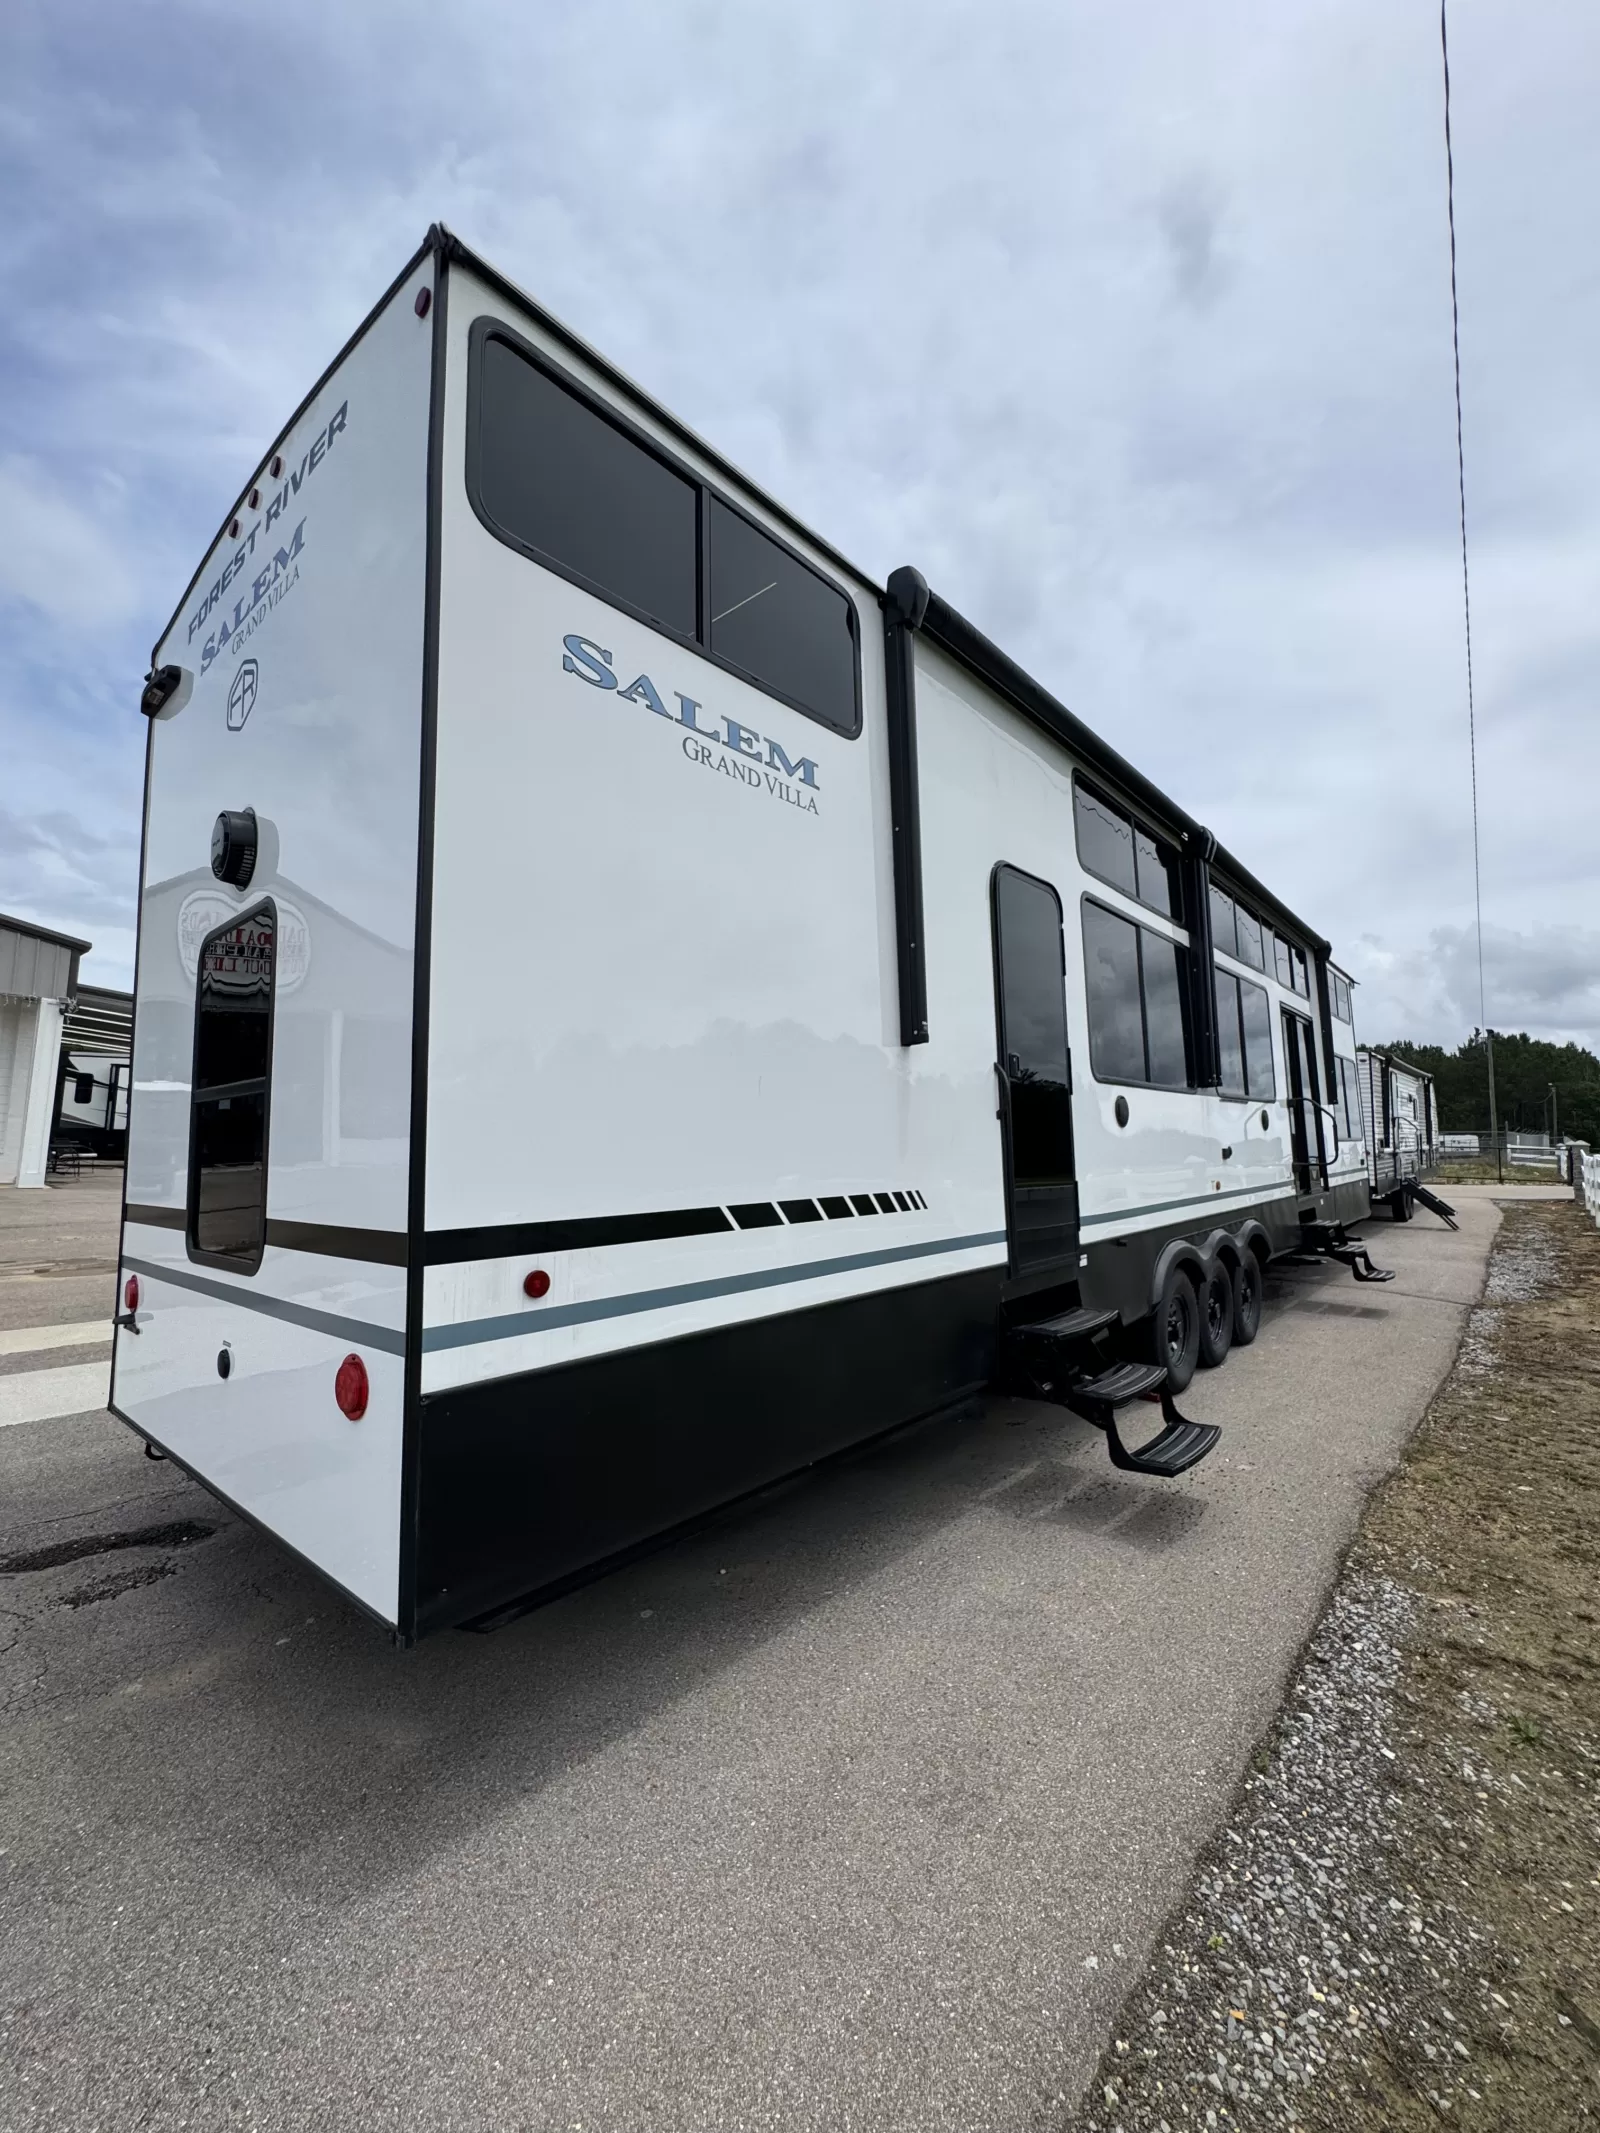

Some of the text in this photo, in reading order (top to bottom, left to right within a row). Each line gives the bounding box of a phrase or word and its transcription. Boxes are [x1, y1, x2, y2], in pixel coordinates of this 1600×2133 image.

[187, 400, 348, 646] FOREST RIVER
[200, 515, 307, 677] SALEM
[231, 564, 300, 656] GRAND VILLA
[562, 634, 820, 791] SALEM
[682, 736, 820, 815] GRAND VILLA
